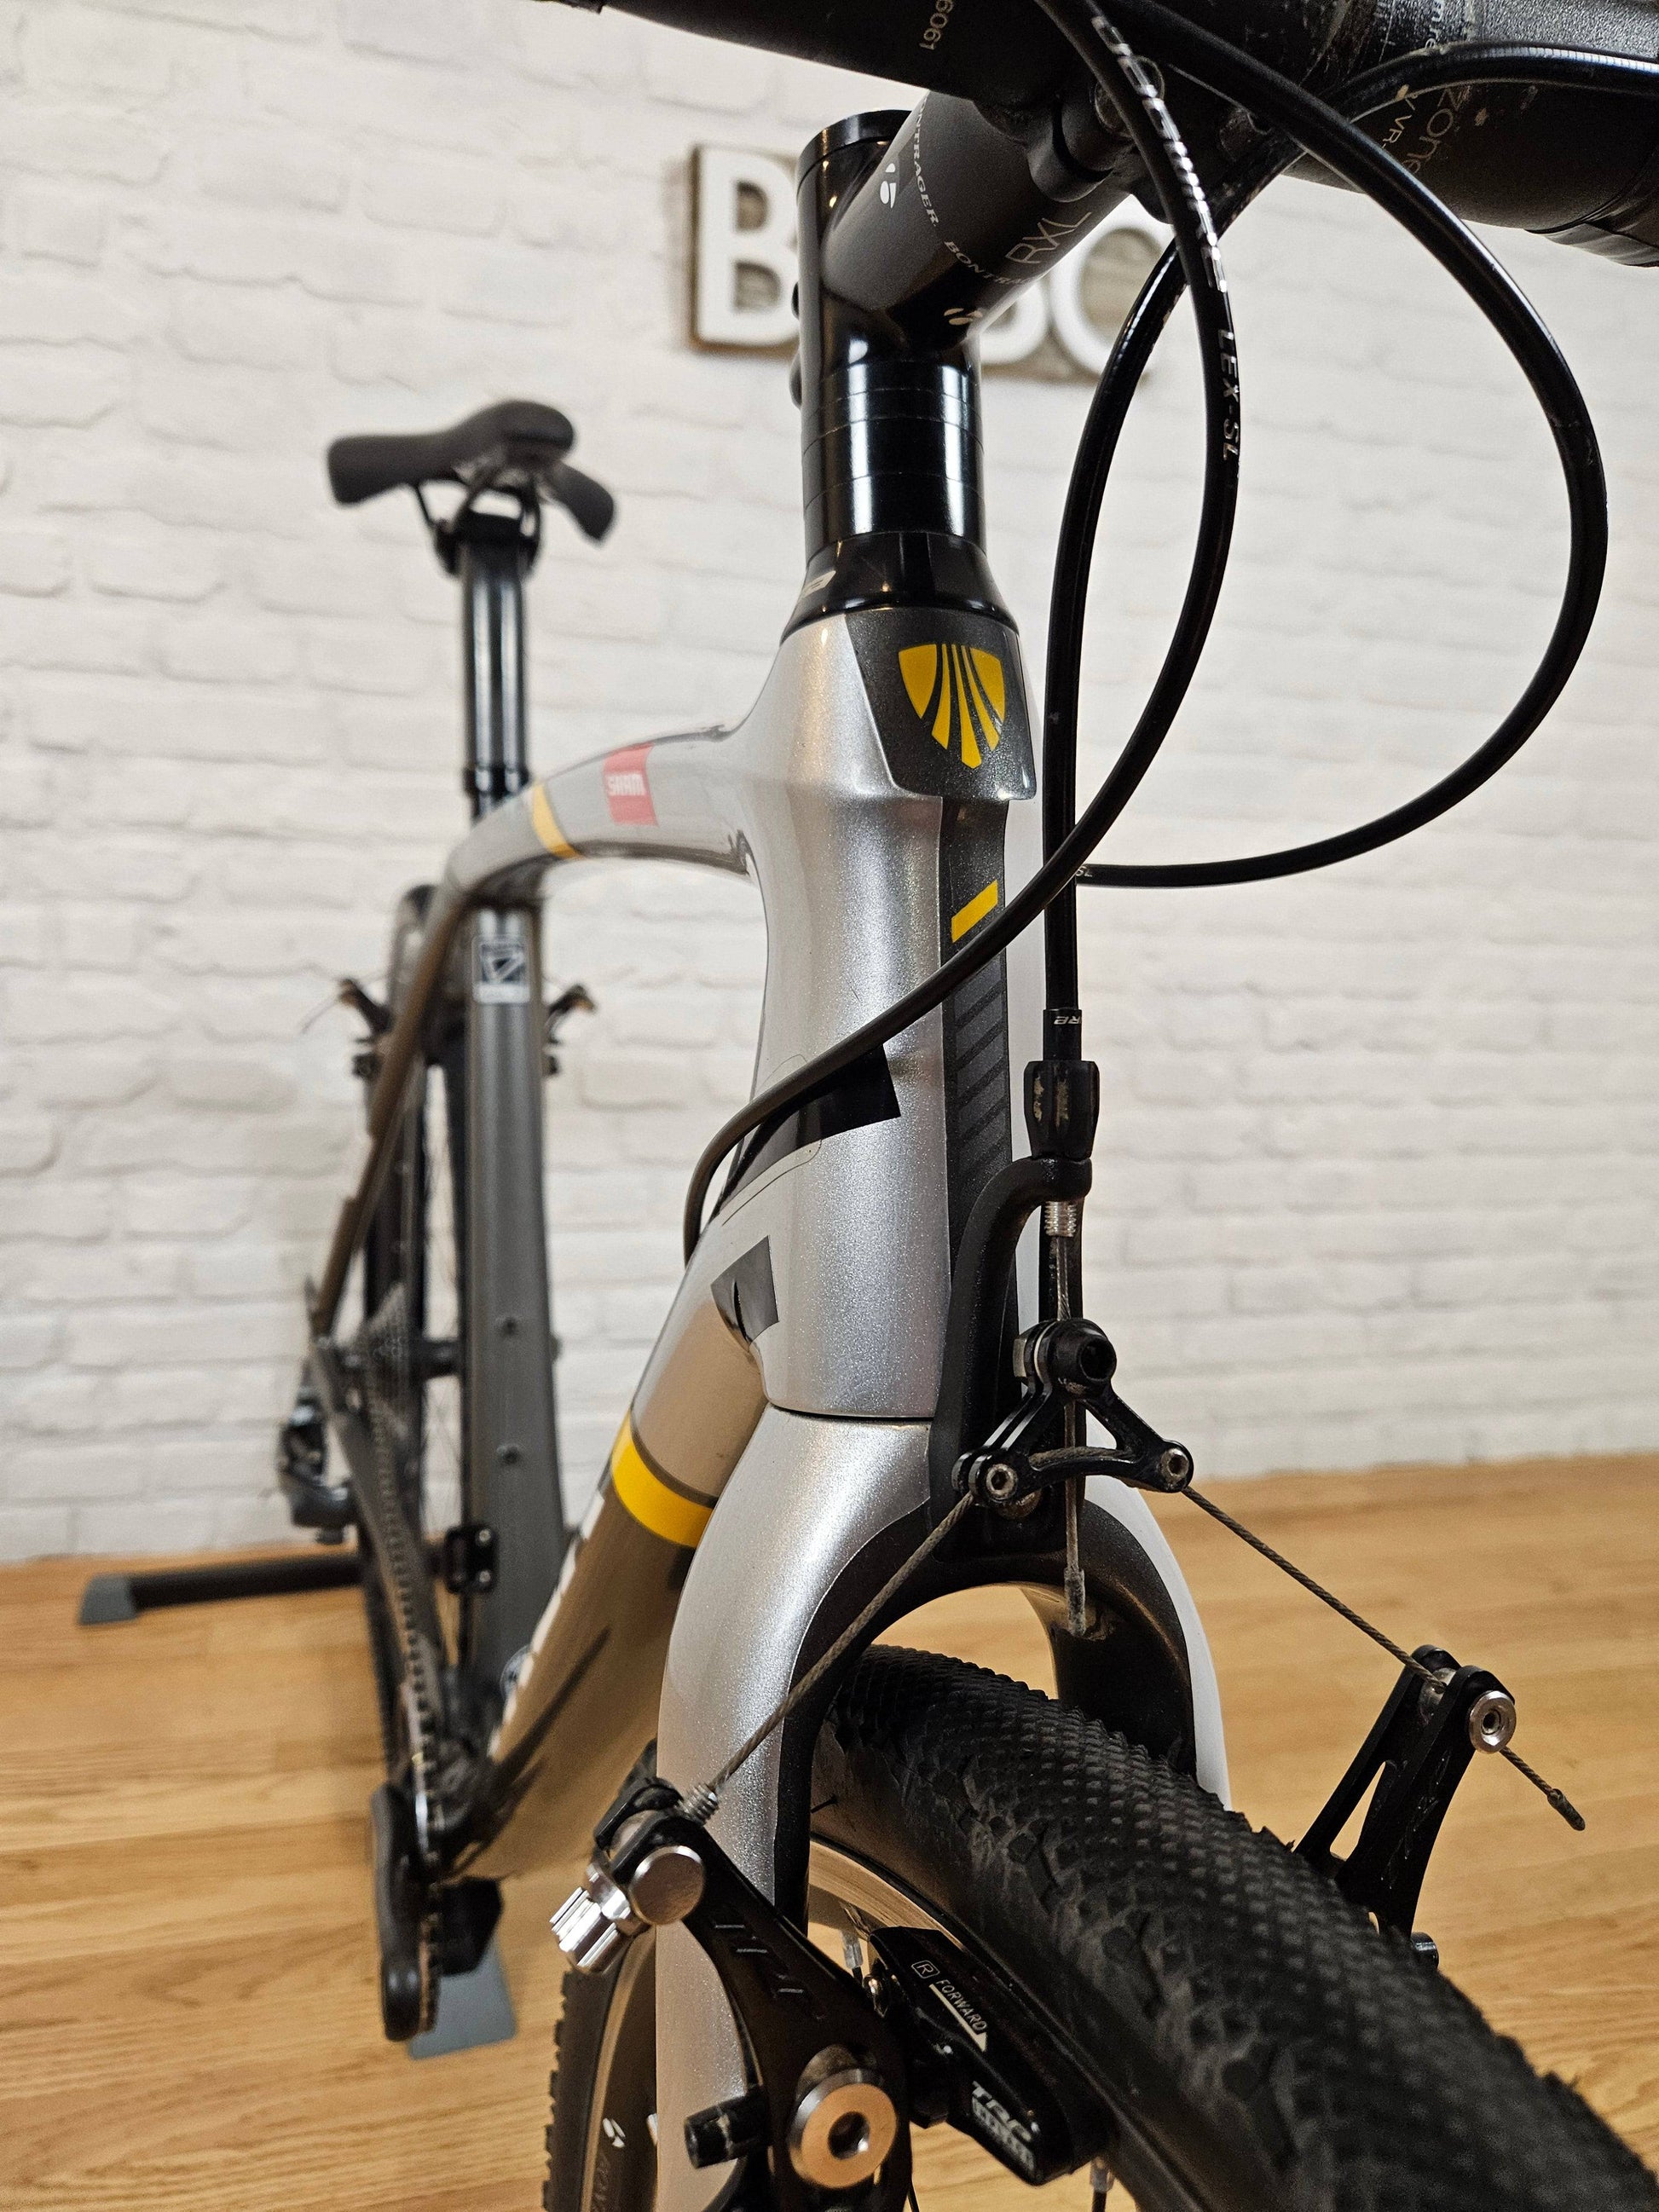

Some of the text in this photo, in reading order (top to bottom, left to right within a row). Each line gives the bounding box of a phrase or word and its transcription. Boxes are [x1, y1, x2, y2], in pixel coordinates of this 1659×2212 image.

[1005, 211, 1092, 264] RXL
[1218, 329, 1240, 461] LEX-SL
[935, 1978, 988, 2032] FORWARD
